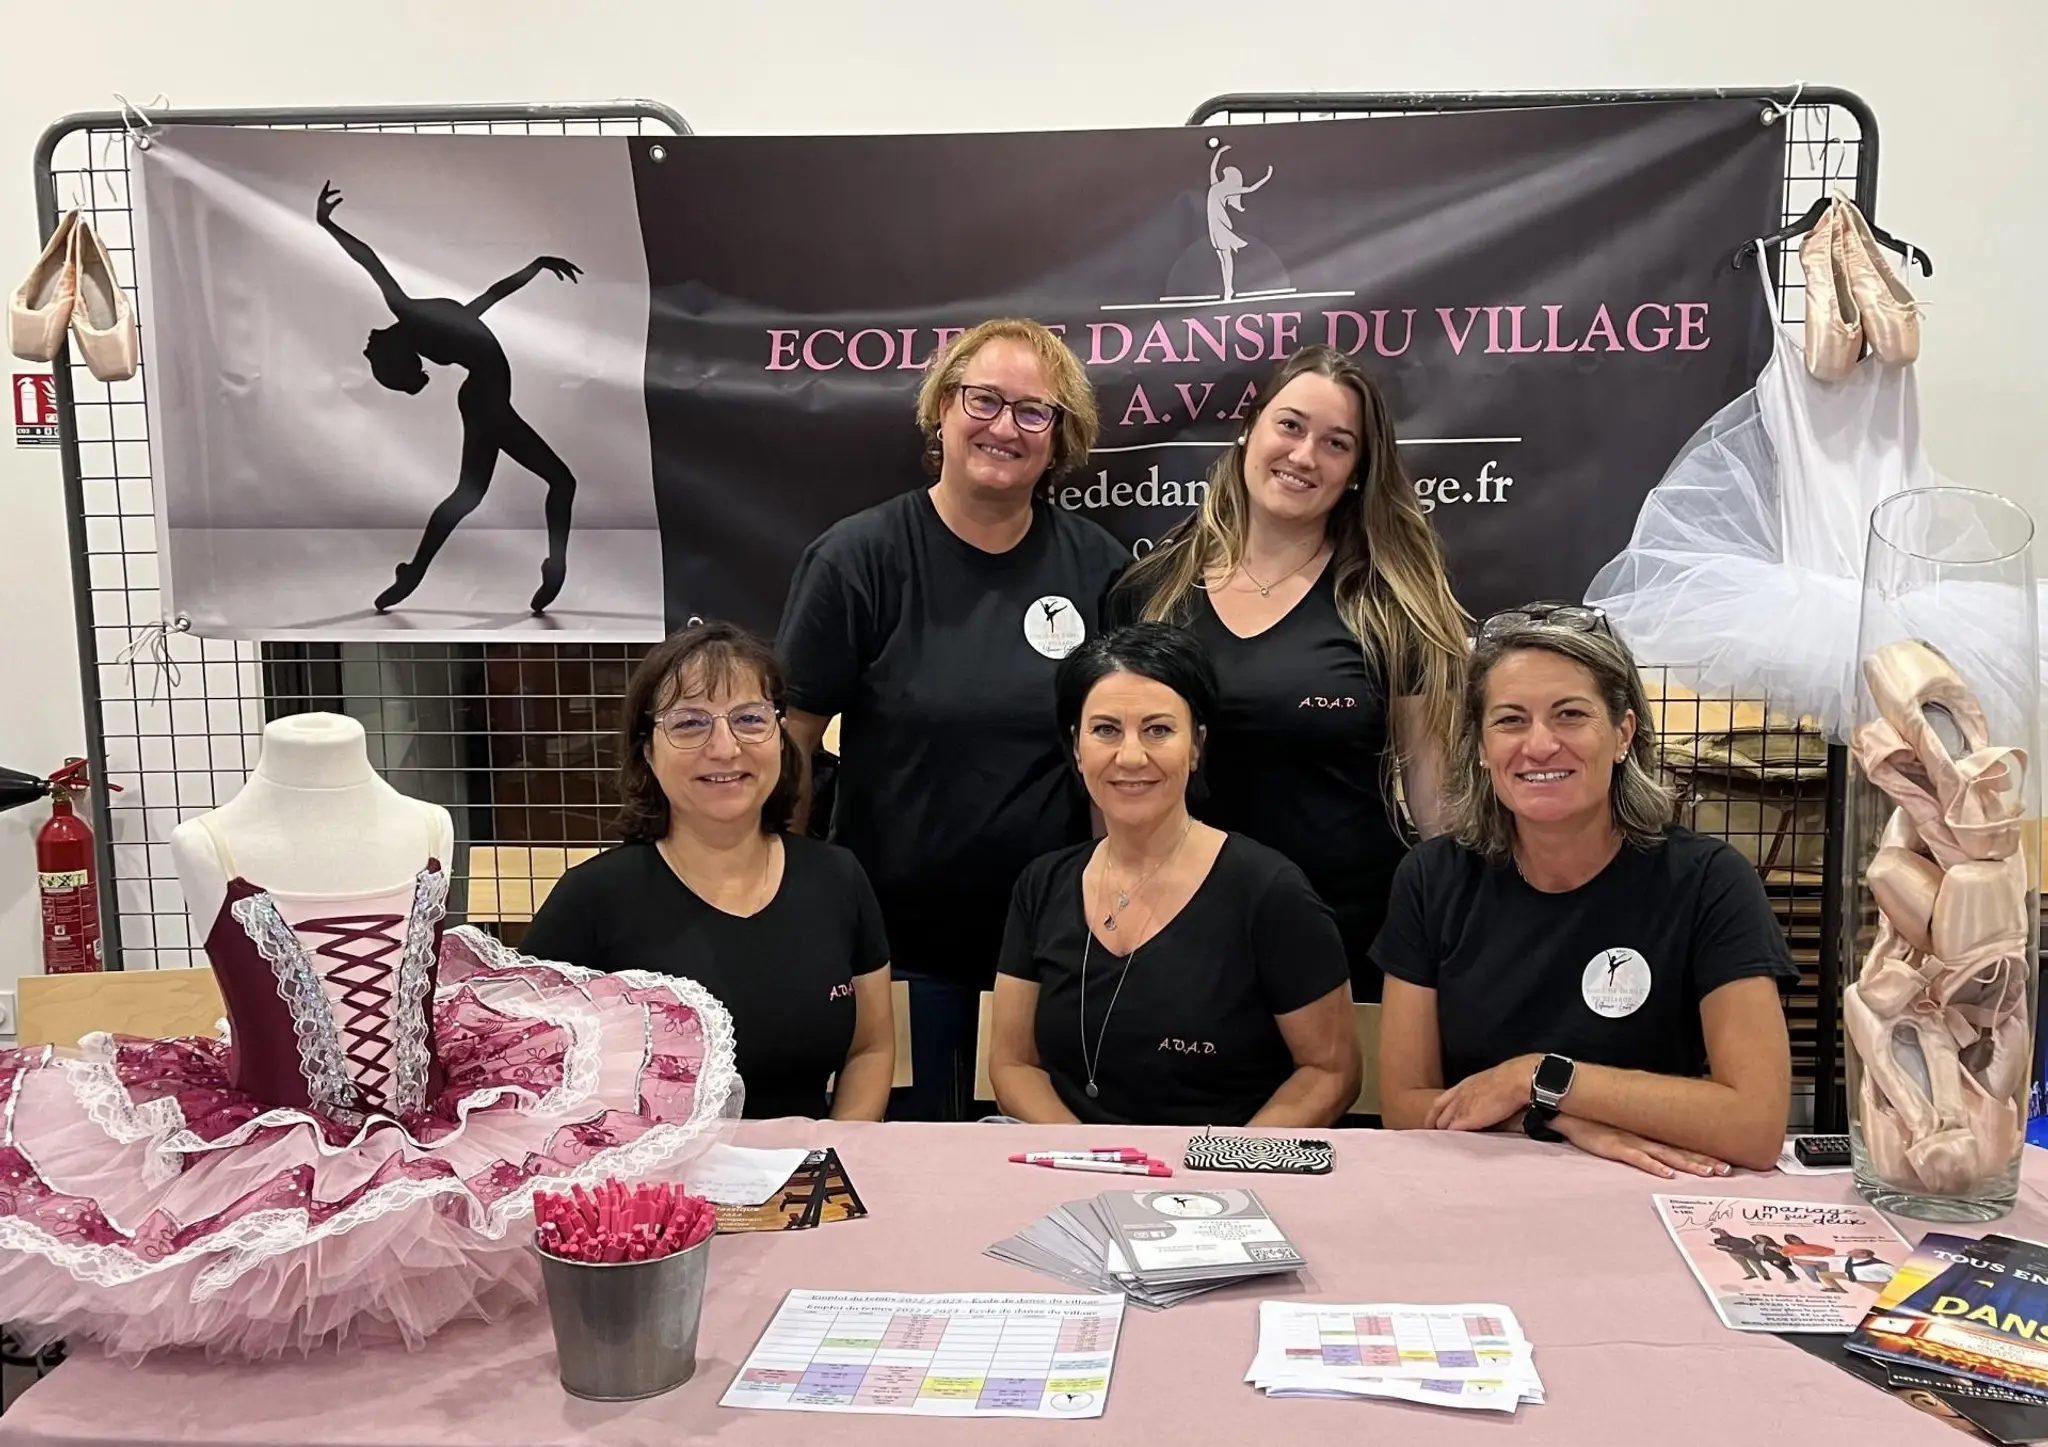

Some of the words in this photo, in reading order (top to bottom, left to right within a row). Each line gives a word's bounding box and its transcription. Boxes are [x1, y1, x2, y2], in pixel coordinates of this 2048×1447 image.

[1086, 310, 1301, 365] DANSE
[1322, 308, 1417, 357] DU
[1435, 302, 1711, 356] VILLAGE
[1119, 379, 1257, 426] A.V.A
[1742, 1207, 1774, 1221] Un
[1763, 1205, 1857, 1220] mariage
[1784, 1213, 1811, 1221] sur
[1813, 1214, 1867, 1225] deux
[1932, 1249, 2007, 1273] TOUS
